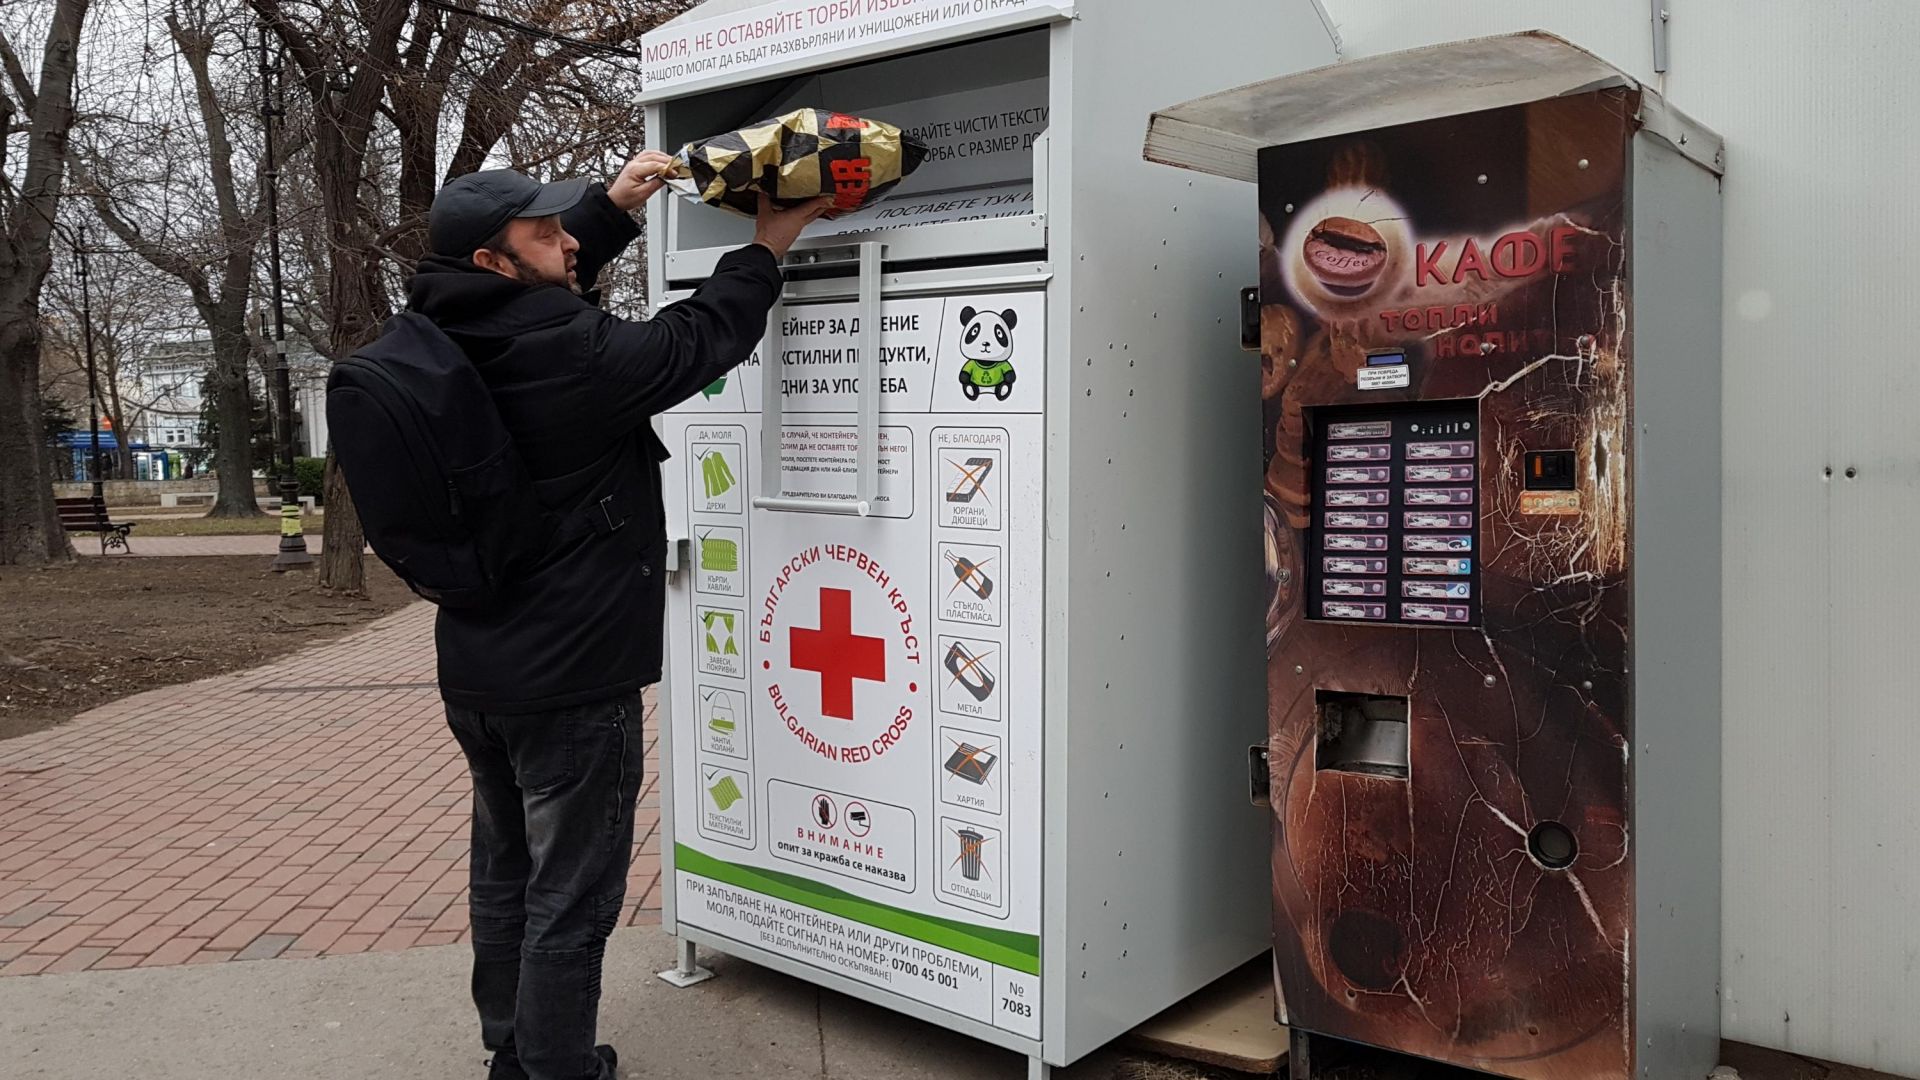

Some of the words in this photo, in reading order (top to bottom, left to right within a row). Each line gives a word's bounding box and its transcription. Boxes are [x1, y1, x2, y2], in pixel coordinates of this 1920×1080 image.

[646, 38, 691, 63] МОЛЯ,
[695, 32, 713, 51] НЕ
[717, 11, 803, 47] ОСТАВЯЙТЕ
[808, 0, 861, 27] ТОРБИ
[645, 66, 684, 83] ЗАЩОТО
[686, 57, 717, 74] МОГАТ
[719, 53, 734, 69] ДА
[735, 46, 768, 63] БЪДАТ
[770, 29, 845, 56] РАЗХВЪРЛЯНИ
[847, 26, 855, 40] И
[859, 8, 939, 38] УНИЩОЖЕНИ
[943, 2, 970, 19] ИЛИ
[954, 114, 998, 136] ЧИСТИ
[922, 146, 955, 163] ОРБА
[957, 143, 967, 157] С
[969, 135, 1019, 156] РАЗМЕР
[875, 197, 978, 220] ПОСТАВЕТЕ
[983, 192, 1017, 207] ТУК
[1315, 250, 1369, 269] Coffee
[1415, 227, 1578, 286] КАФЕ
[782, 317, 825, 336] ЕЙНЕР
[829, 319, 846, 335] ЗА
[812, 379, 829, 394] ЗА
[699, 431, 711, 440] ДА,
[711, 431, 732, 439] МОЛЯ
[786, 431, 811, 439] СЛУЧАЙ,
[938, 434, 951, 444] НЕ,
[953, 434, 1001, 445] БЛАГОДАРЯ
[799, 443, 808, 451] ДА
[706, 502, 726, 510] ДРЕХИ
[953, 506, 987, 517] ЮРГАНИ,
[951, 515, 988, 527] ДЮШЕЦИ
[707, 575, 729, 585] КЪРПИ,
[707, 583, 732, 592] ХАВЛИИ
[760, 546, 821, 643] БЪЛГАРСКИ
[825, 544, 890, 589] ЧЕРВЕН
[888, 588, 920, 664] КРЪСТ
[953, 600, 985, 613] СТЪКЛО,
[946, 609, 993, 622] ПЛАСТМАСА
[706, 663, 737, 674] ПОКРИВКИ
[709, 656, 731, 666] ЗАВЕСИ,
[957, 703, 983, 715] МЕТАЛ
[768, 684, 837, 760] BULGARIAN
[842, 745, 871, 763] RED
[872, 705, 913, 755] CROSS
[711, 743, 735, 753] КОЛАНИ
[956, 794, 985, 808] ХАРТИЯ
[709, 813, 742, 827] ТЕКСТИЛНИ
[709, 820, 744, 835] МАТЕРИАЛИ
[797, 828, 884, 859] ВНИМАНИЕ
[778, 841, 800, 854] опит
[802, 847, 812, 857] за
[814, 850, 850, 867] кражба
[852, 860, 863, 870] се
[865, 863, 906, 882] наказва
[951, 883, 992, 901] ОТПАДЪЦИ
[686, 879, 705, 893] ПРИ
[706, 885, 761, 911] ЗАПЪЛВАНЕ
[764, 900, 777, 914] НА
[780, 905, 845, 936] КОНТЕЙНЕРА
[848, 927, 871, 945] ИЛИ
[874, 936, 909, 955] ДРУГИ
[912, 947, 983, 981] ПРОБЛЕМИ,
[706, 900, 737, 920] МОЛЯ,
[739, 910, 785, 934] ПОДАЙТЕ
[787, 925, 827, 947] СИГНАЛ
[829, 938, 844, 952] НА
[847, 945, 889, 967] НОМЕР:
[892, 957, 919, 976] 0700
[921, 967, 935, 981] 45
[938, 973, 959, 989] 001
[776, 936, 836, 963] ДОПЪЛНИТЕЛНО
[1002, 998, 1032, 1018] 7083
